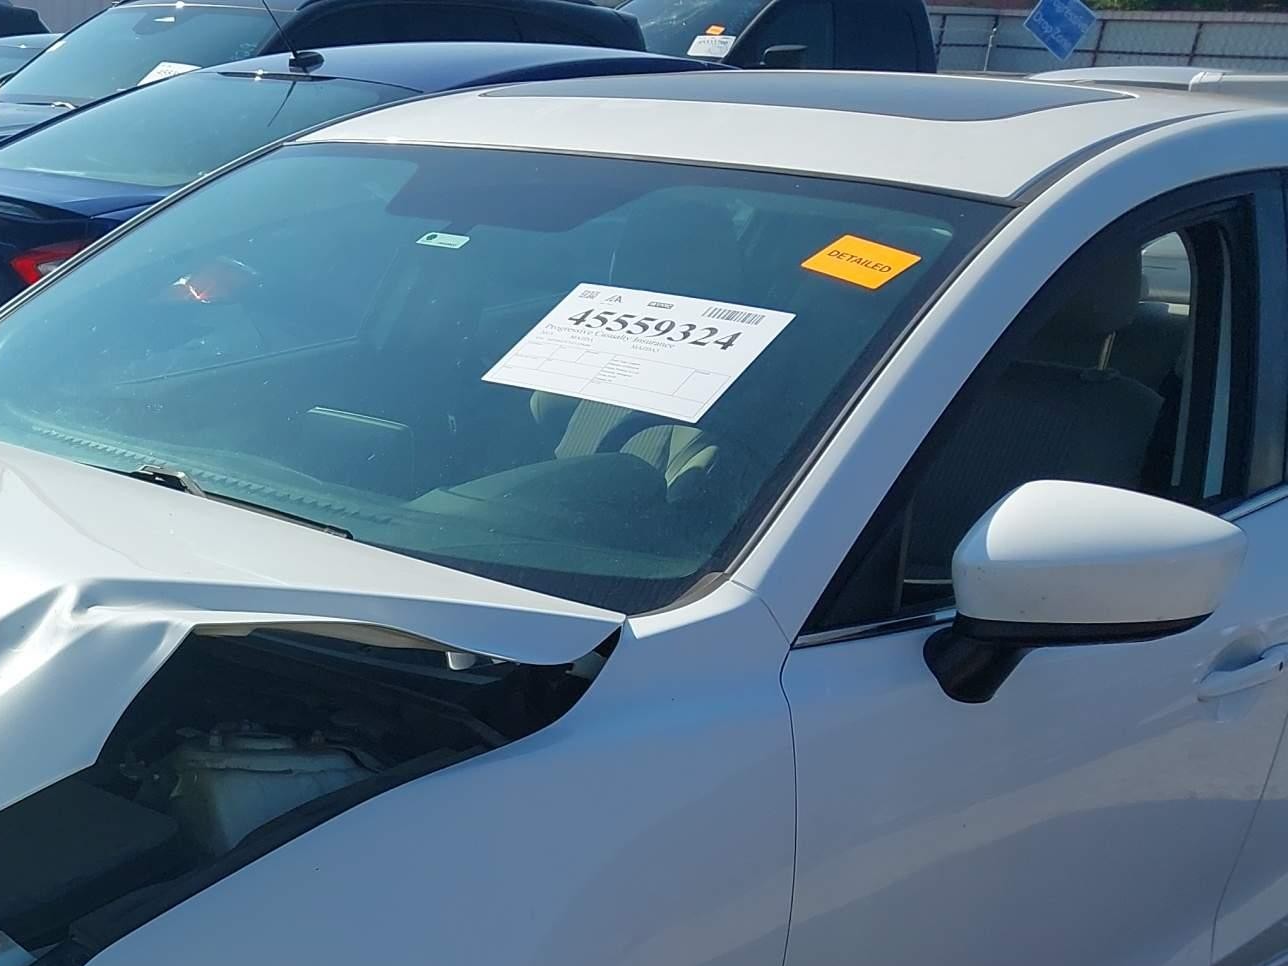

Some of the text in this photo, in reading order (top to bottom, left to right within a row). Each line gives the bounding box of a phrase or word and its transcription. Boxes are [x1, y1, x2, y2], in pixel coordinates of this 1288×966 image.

[827, 249, 892, 273] DETAILED
[545, 323, 593, 336] Progressive
[594, 329, 631, 342] Casualty
[632, 336, 675, 349] Insurance
[567, 308, 742, 351] 45559324
